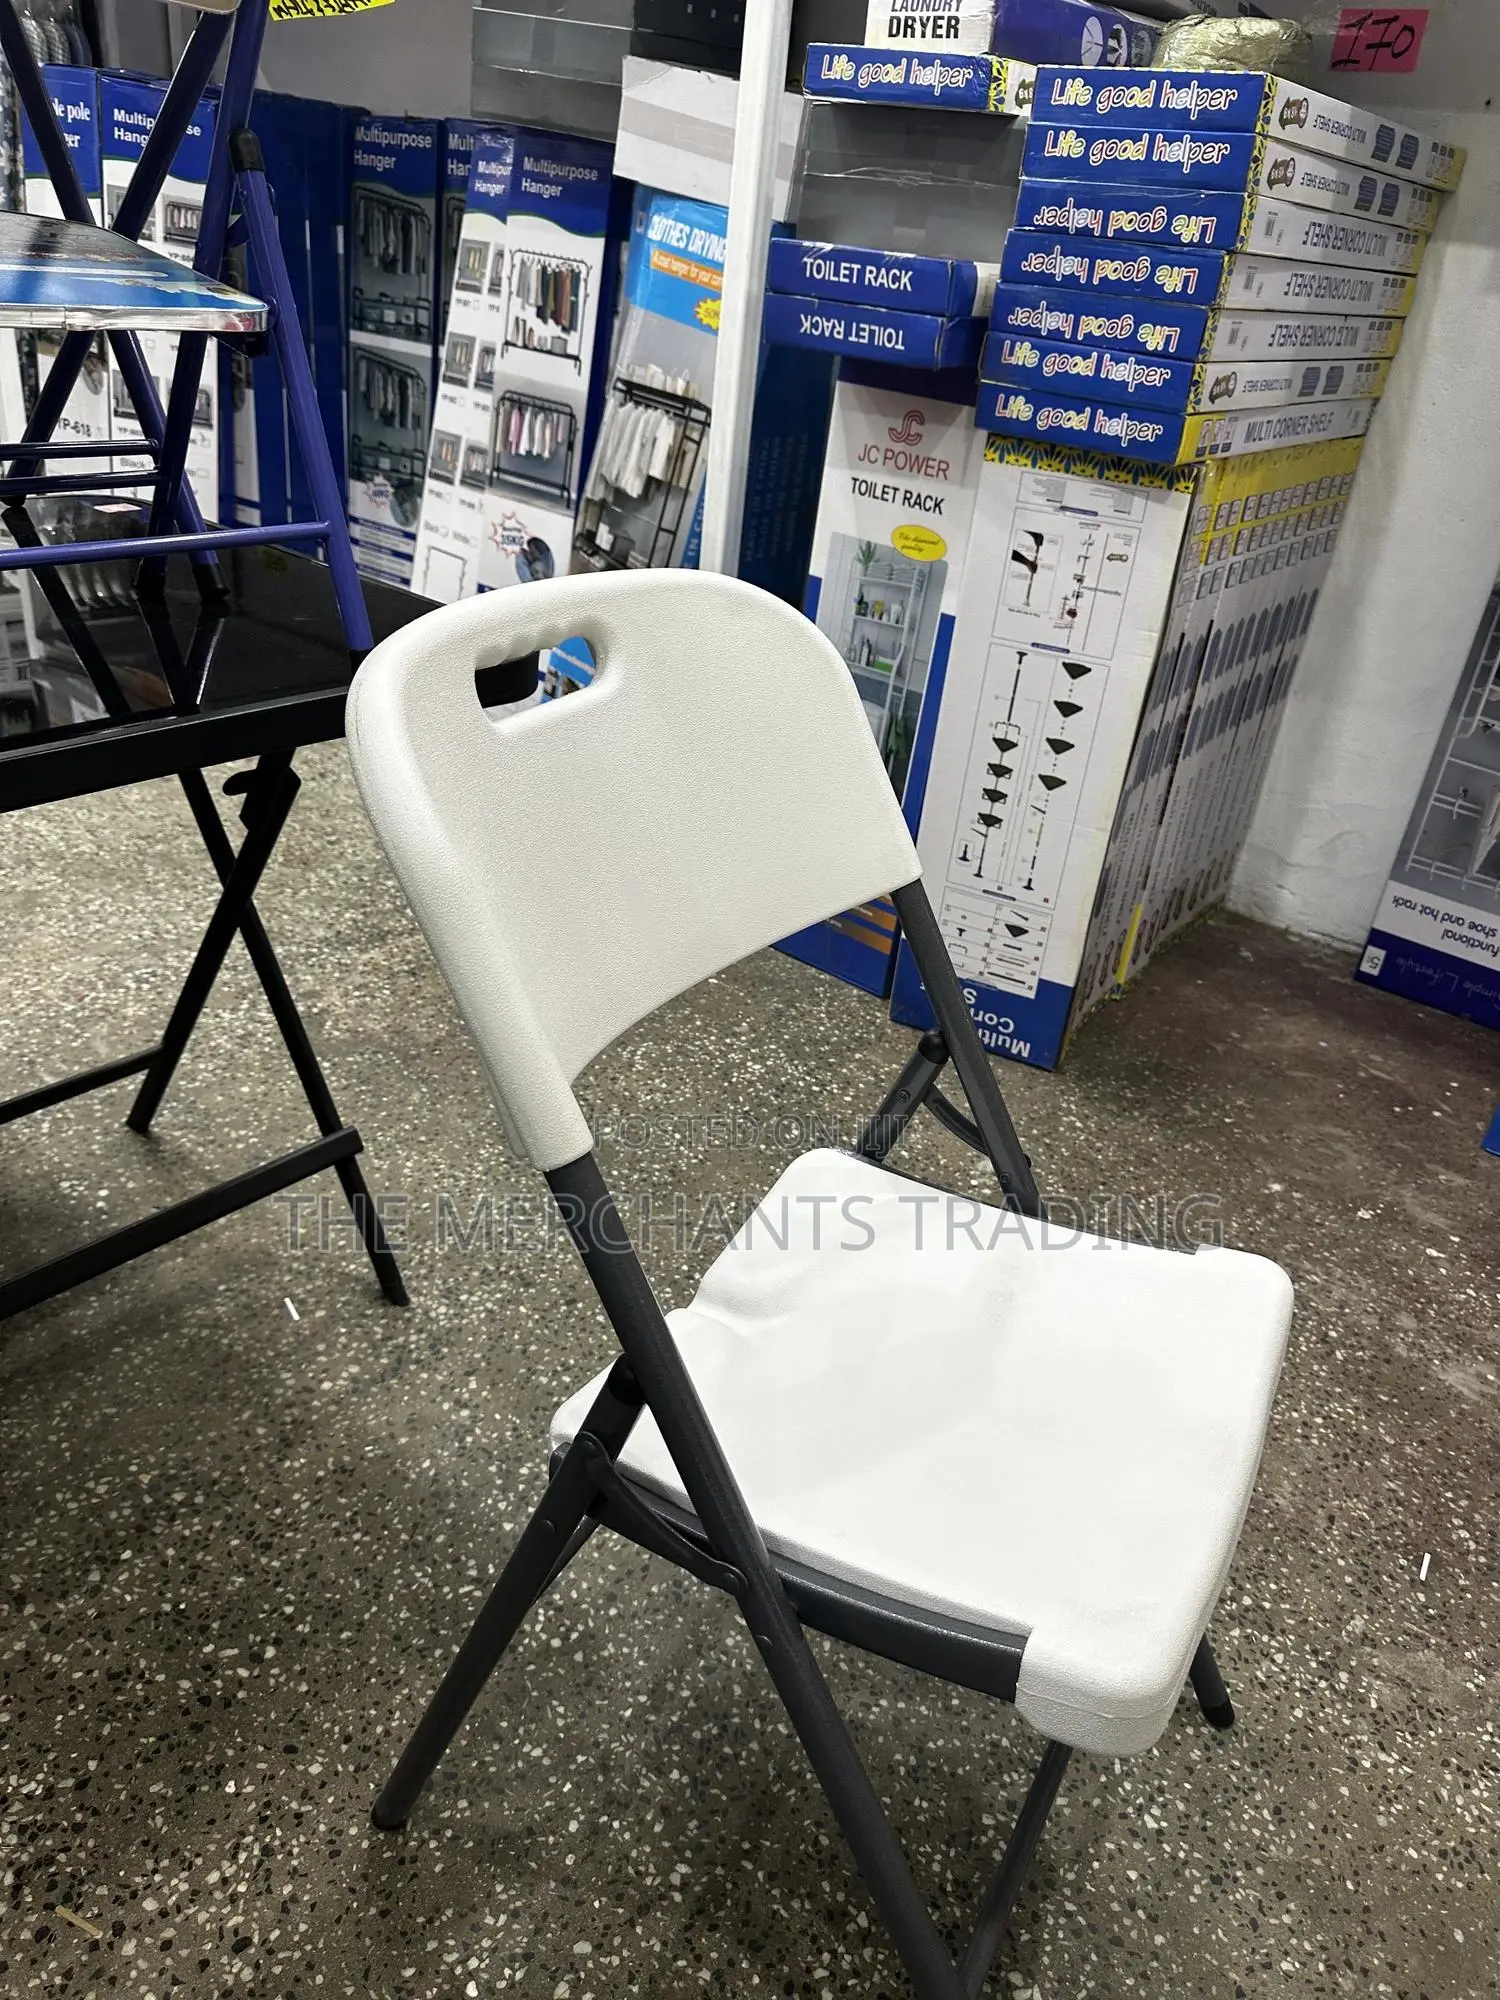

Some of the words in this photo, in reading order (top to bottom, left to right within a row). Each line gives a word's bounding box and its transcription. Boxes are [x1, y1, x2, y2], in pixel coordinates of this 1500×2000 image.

[888, 15, 960, 39] DRYER
[1332, 12, 1416, 69] 170
[821, 55, 855, 80] Life
[858, 59, 905, 88] good
[909, 58, 974, 95] helper
[67, 102, 92, 123] pole
[1051, 78, 1092, 106] Life
[1096, 79, 1157, 113] good
[1159, 79, 1238, 120] helper
[355, 125, 433, 150] Multipurpose
[1044, 131, 1086, 158] Life
[1089, 133, 1149, 166] good
[1152, 133, 1230, 173] helper
[353, 149, 396, 172] Hanger
[523, 156, 599, 181] Multipurpose
[474, 179, 506, 197] Hanger
[521, 177, 563, 199] Hanger
[1034, 197, 1103, 236] helper
[1107, 206, 1166, 238] good
[1171, 214, 1217, 243] Life
[1302, 221, 1334, 248] SHELF
[803, 258, 862, 284] TOILET
[864, 267, 914, 292] RACK
[1021, 245, 1089, 285] helper
[1092, 256, 1150, 286] good
[1154, 264, 1199, 294] Life
[1284, 272, 1316, 297] SHELF
[799, 314, 844, 339] RACK
[1008, 301, 1074, 339] helper
[1077, 313, 1134, 339] good
[848, 324, 905, 350] TOILET
[1137, 323, 1180, 353] Life
[1268, 324, 1300, 347] SHELF
[1001, 340, 1040, 368] Life
[1043, 349, 1095, 378] good
[1099, 353, 1171, 392] helper
[995, 393, 1034, 421] Life
[1037, 402, 1089, 431] good
[1092, 407, 1164, 447] helper
[1243, 419, 1274, 444] MULTI
[1273, 414, 1308, 439] CORNER
[857, 443, 880, 464] JC
[882, 449, 950, 481] POWER
[851, 476, 900, 504] TOILET
[902, 489, 945, 516] RACK
[1440, 913, 1466, 926] and
[1468, 921, 1498, 938] shoe
